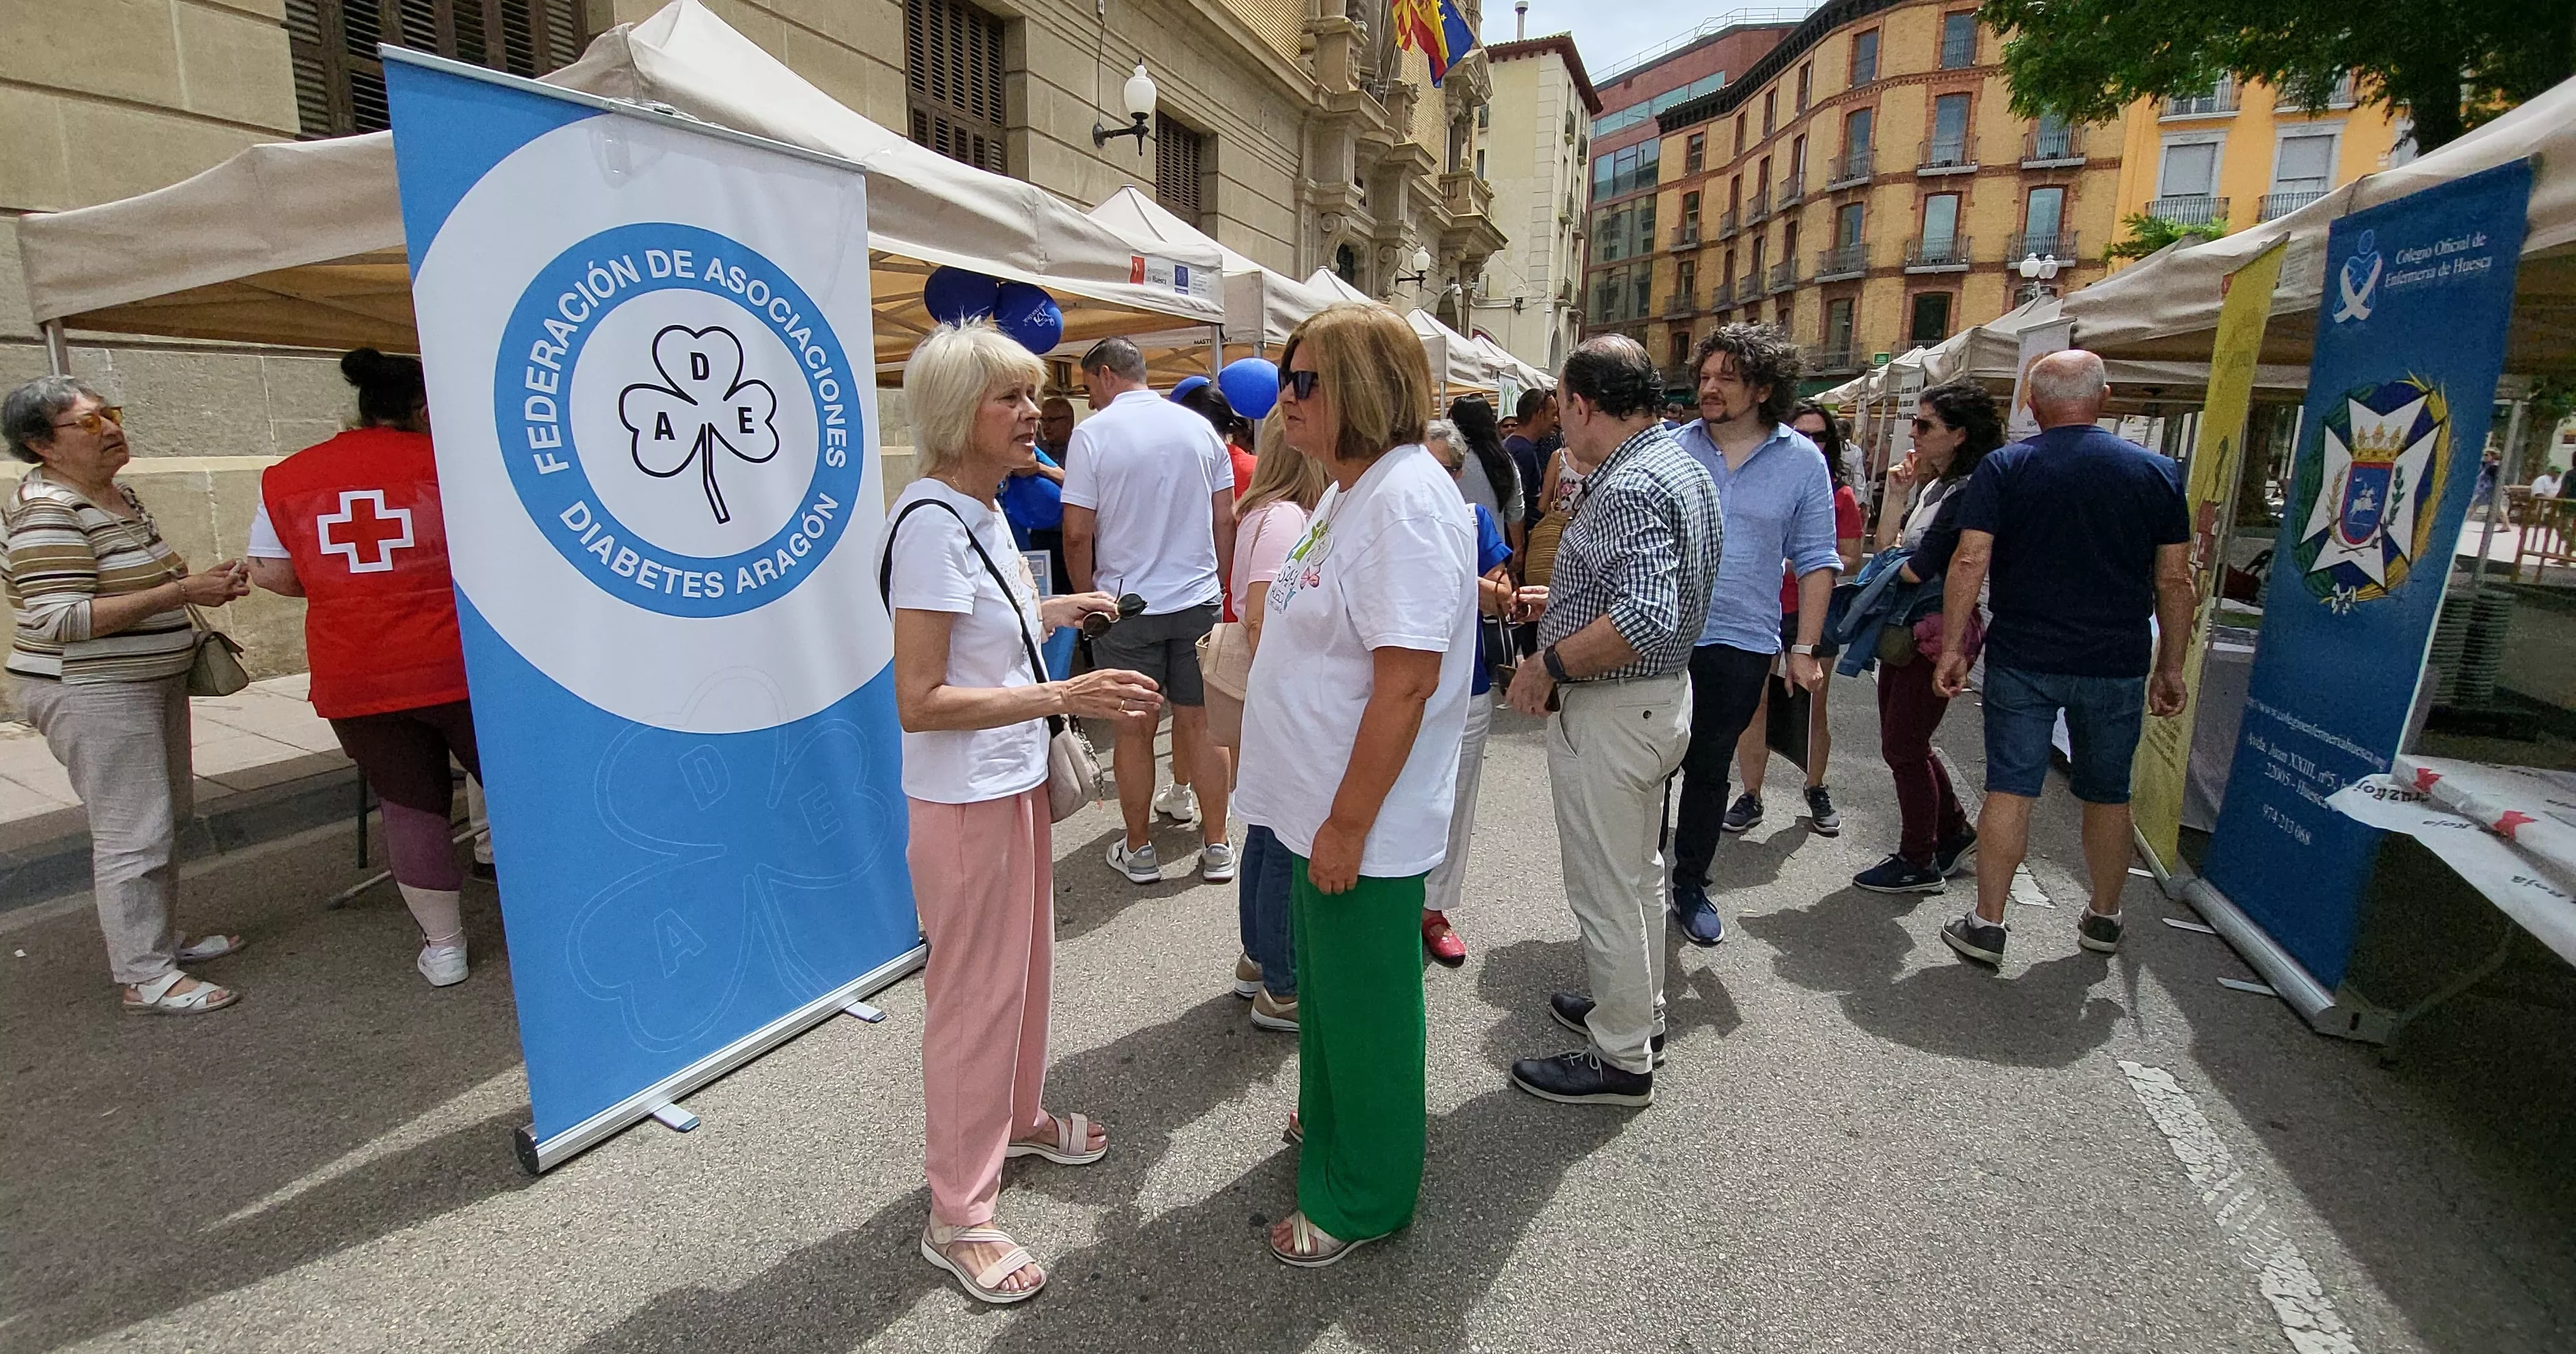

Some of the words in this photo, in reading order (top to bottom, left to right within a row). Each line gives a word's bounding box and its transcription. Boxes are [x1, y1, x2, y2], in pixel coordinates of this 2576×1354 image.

[2472, 231, 2487, 248] de
[2438, 261, 2451, 277] de
[2453, 256, 2493, 274] Huesca
[524, 253, 640, 475] FEDERACIÓN
[646, 249, 696, 279] DE
[704, 258, 847, 468] ASOCIACIONES
[690, 352, 710, 380] D
[560, 500, 725, 598] DIABETES
[736, 492, 838, 594] ARAGÓN
